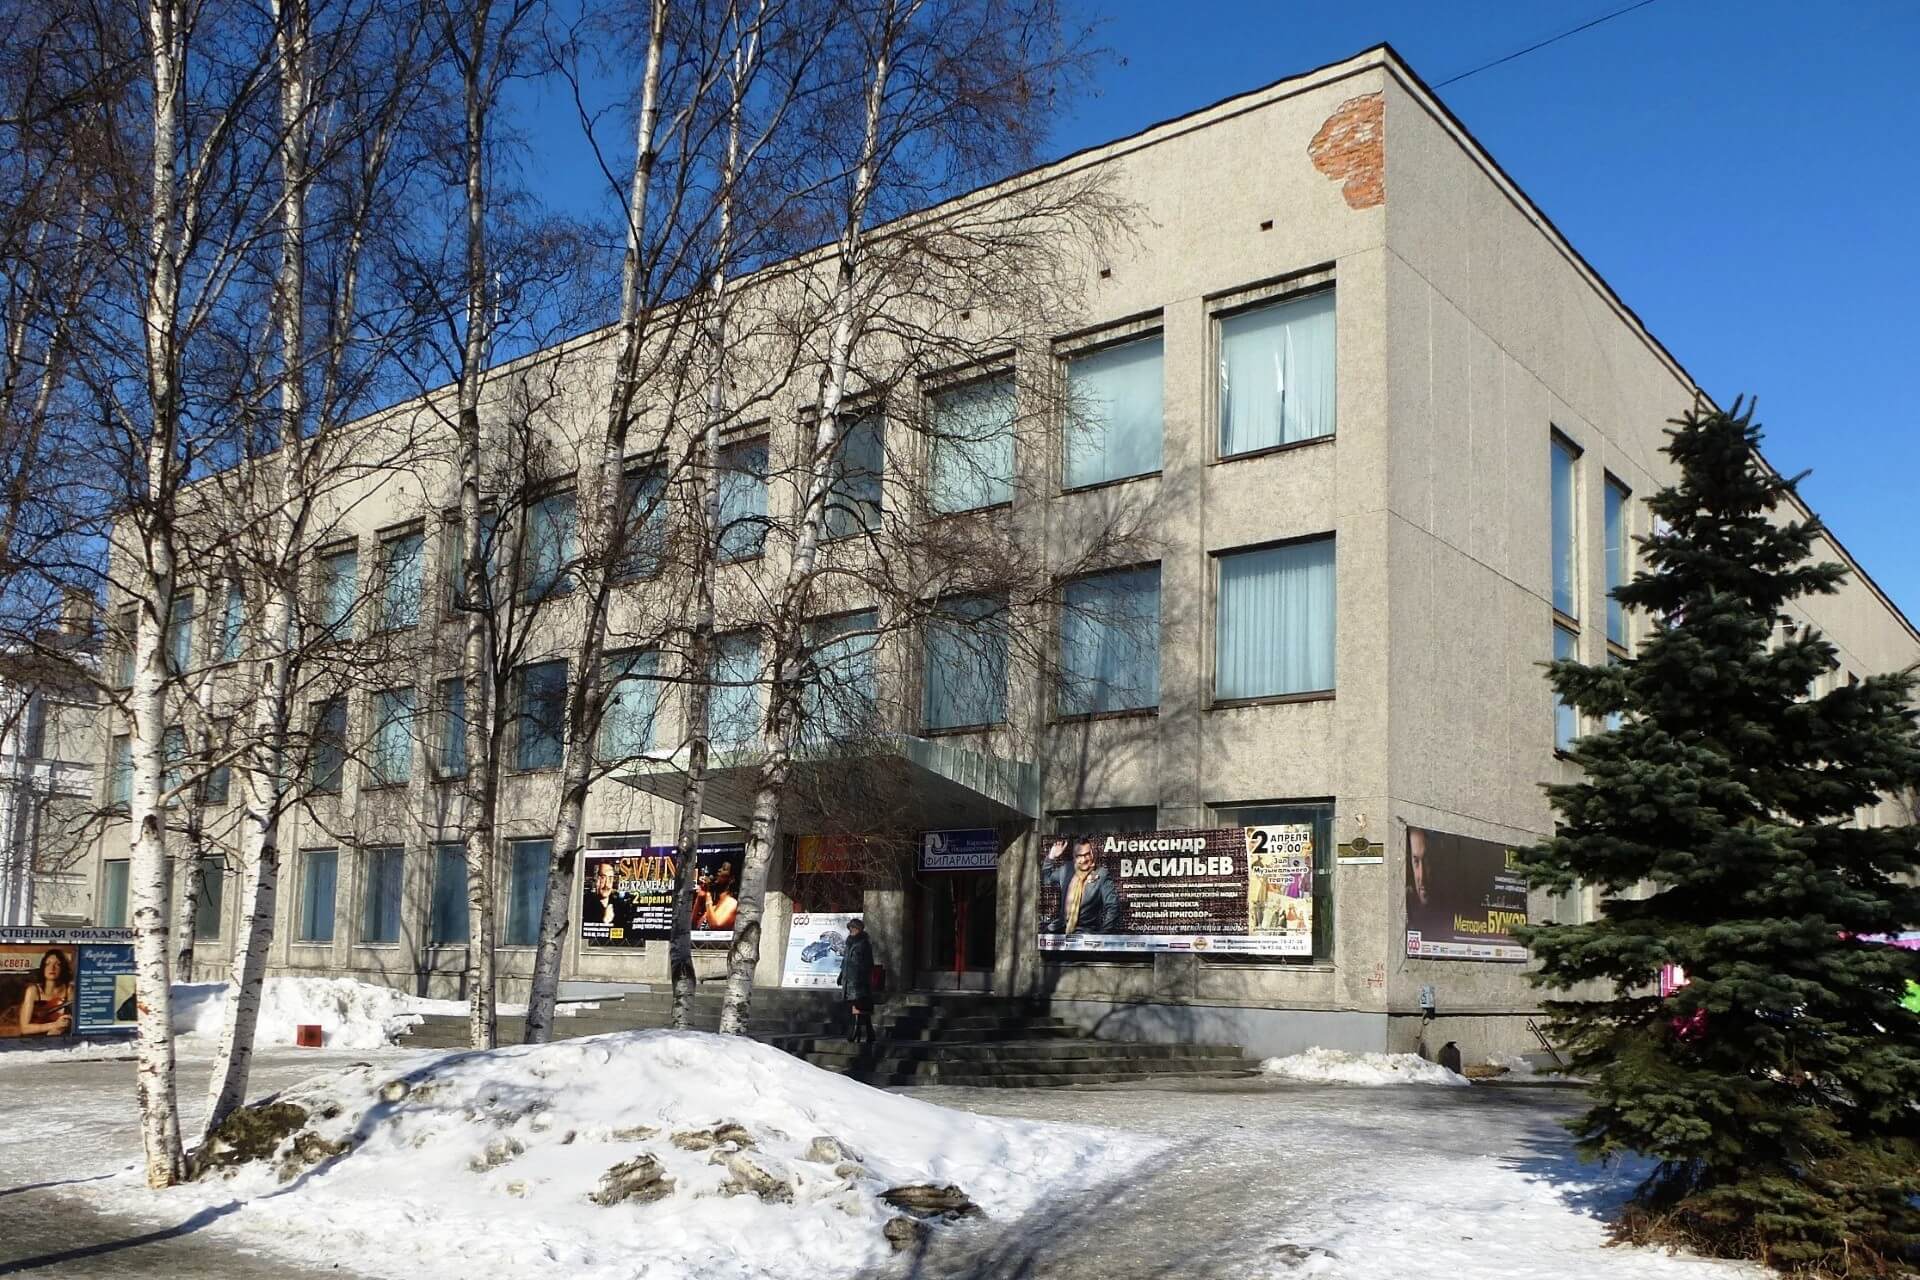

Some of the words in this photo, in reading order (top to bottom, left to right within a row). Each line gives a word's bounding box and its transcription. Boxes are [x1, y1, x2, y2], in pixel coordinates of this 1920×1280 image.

[1252, 830, 1268, 854] 2
[1270, 833, 1308, 843] АПРЕЛЯ
[1104, 836, 1206, 854] Александр
[925, 854, 998, 866] ФИЛАРМОНИ
[1120, 856, 1234, 878] ВАСИЛЬЕВ
[0, 929, 66, 938] СТВЕННАЯ
[4, 959, 30, 968] света
